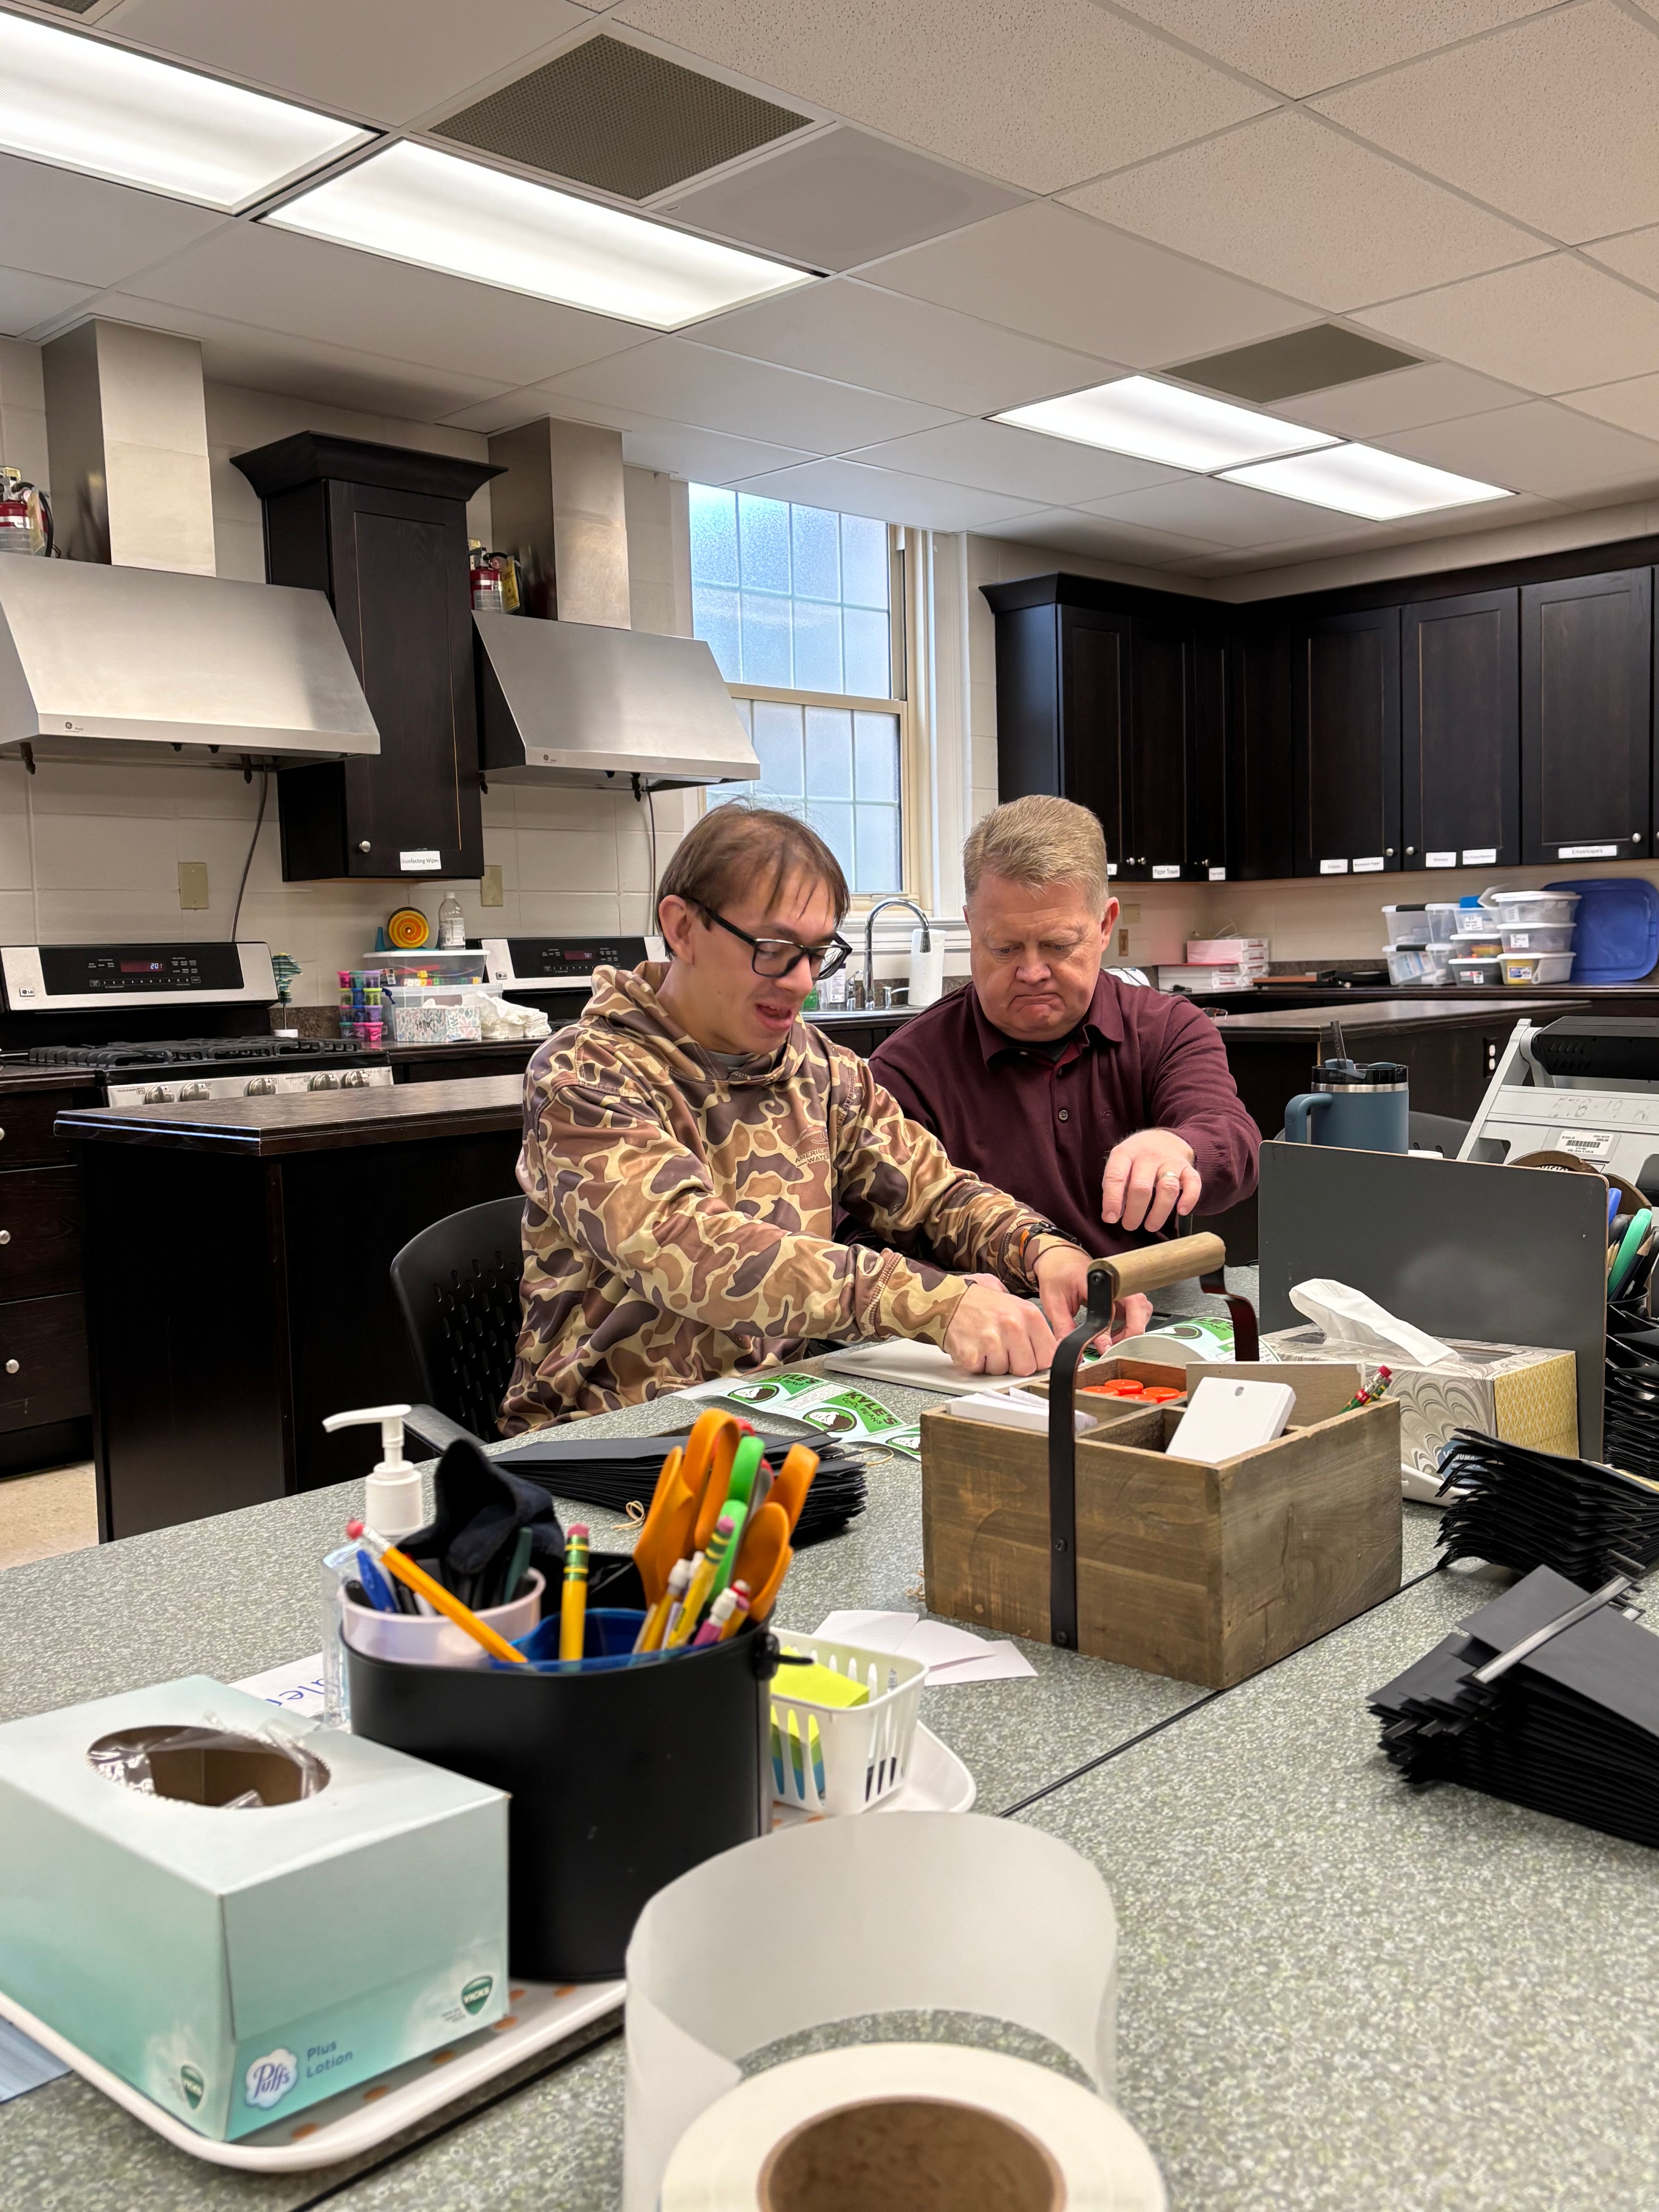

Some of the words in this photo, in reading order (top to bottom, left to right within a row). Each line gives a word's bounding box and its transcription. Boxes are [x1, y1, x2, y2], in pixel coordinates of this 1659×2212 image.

[415, 1019, 436, 1033] Dallas
[842, 1397, 859, 1409] COOL
[860, 1408, 883, 1425] BEANS
[845, 1391, 898, 1425] KYLE'S
[464, 1986, 490, 2004] VICKS
[306, 2040, 337, 2061] Plus
[306, 2051, 353, 2078] Lotion
[253, 2063, 290, 2099] Puffs
